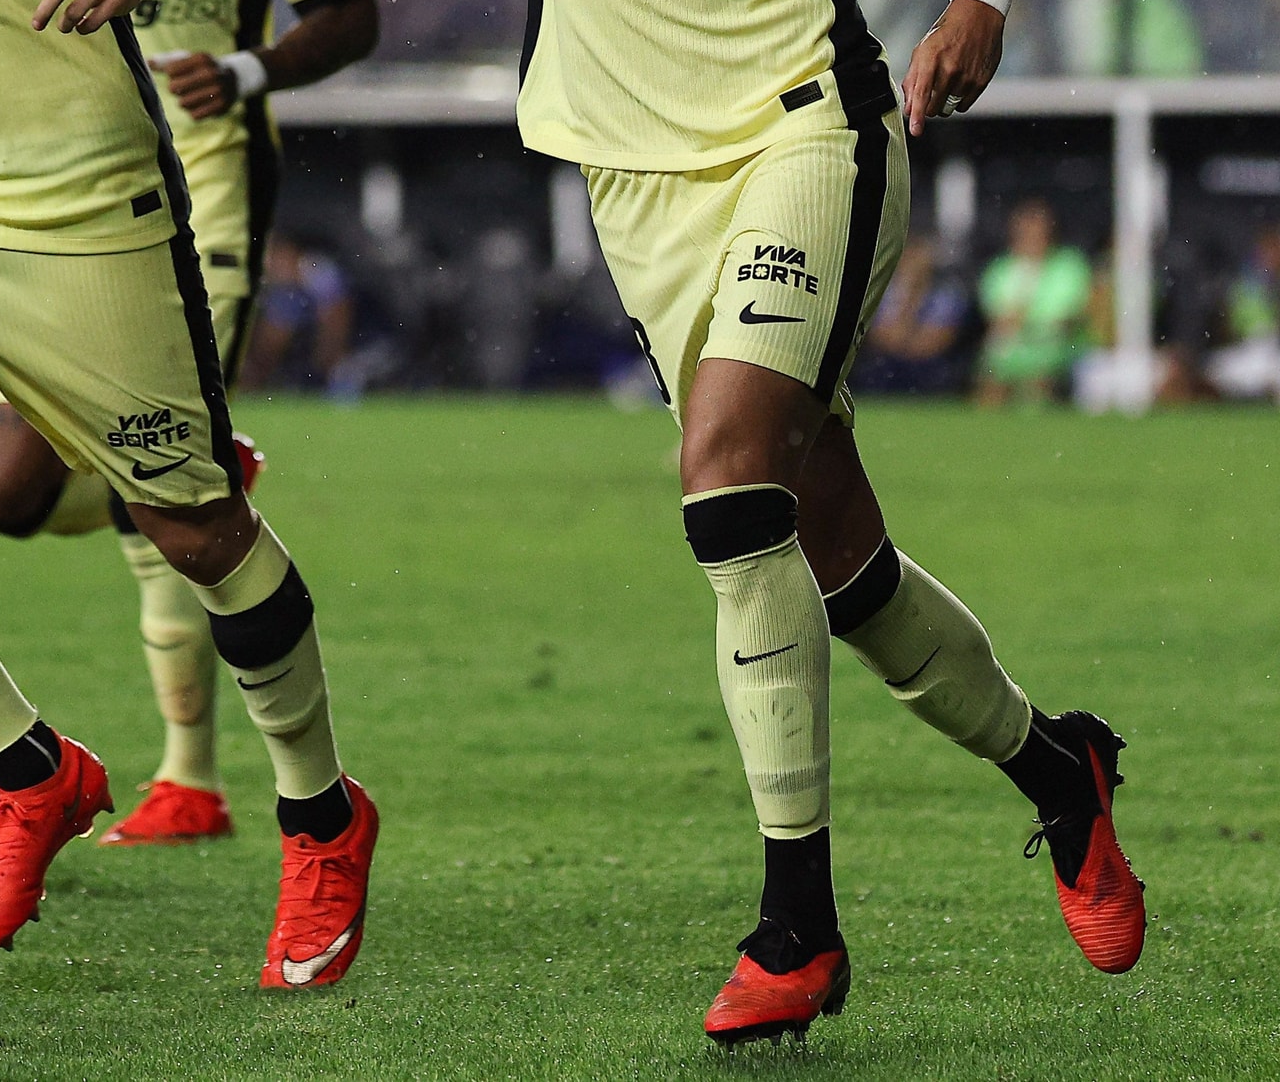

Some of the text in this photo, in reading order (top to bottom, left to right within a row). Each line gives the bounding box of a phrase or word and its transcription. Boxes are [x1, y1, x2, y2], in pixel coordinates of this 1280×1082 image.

[753, 245, 806, 268] VIVA
[737, 263, 819, 295] SORTE
[118, 408, 171, 431] VIVA
[107, 421, 190, 448] SORTE
